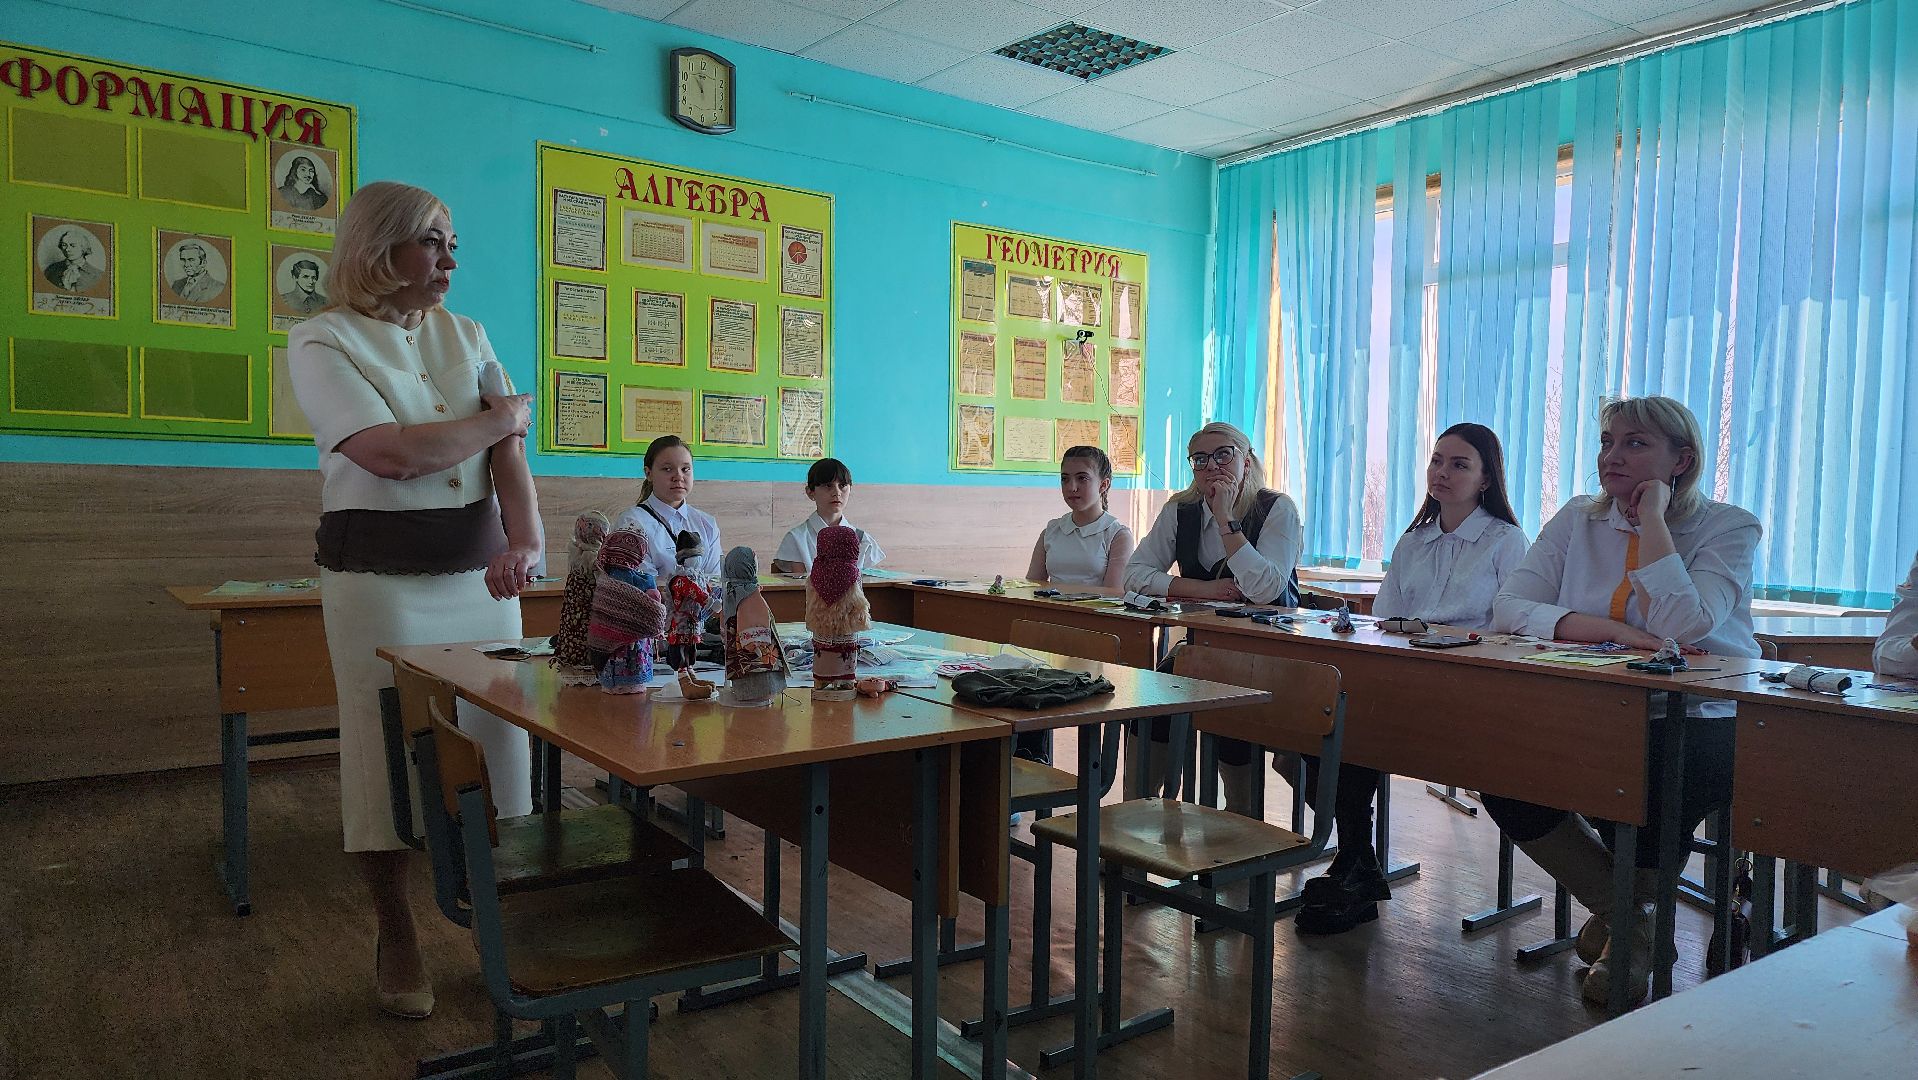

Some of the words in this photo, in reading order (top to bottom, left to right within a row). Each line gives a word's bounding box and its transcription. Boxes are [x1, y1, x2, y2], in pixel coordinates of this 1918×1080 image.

[688, 61, 694, 72] 11
[700, 60, 707, 71] 12
[681, 70, 689, 82] 10
[681, 83, 687, 94] 9
[719, 79, 724, 89] 2
[0, 57, 327, 146] ФОРМАЦИЯ
[681, 95, 687, 106] 8
[719, 91, 724, 102] 3
[700, 113, 705, 123] 6
[713, 112, 718, 122] 5
[615, 167, 771, 222] АЛГЕБРА
[985, 233, 1122, 278] ГЕОМЕТРИЯ
